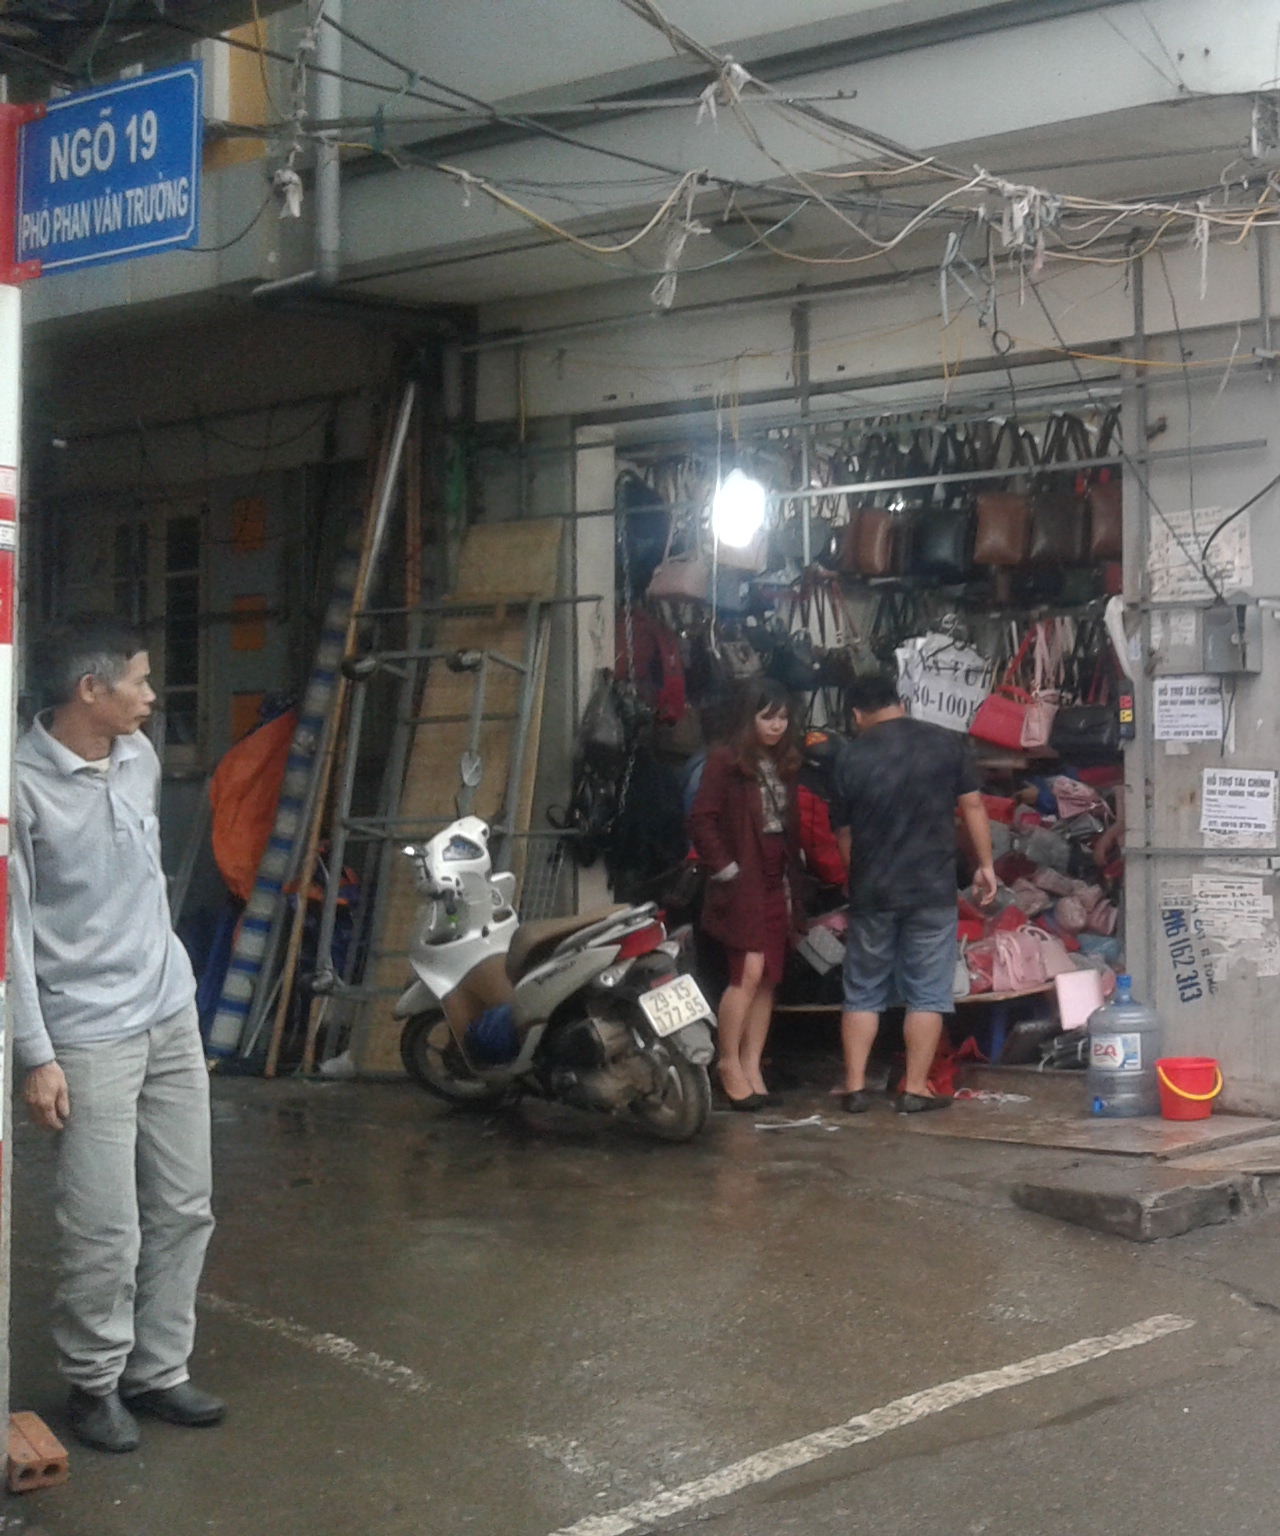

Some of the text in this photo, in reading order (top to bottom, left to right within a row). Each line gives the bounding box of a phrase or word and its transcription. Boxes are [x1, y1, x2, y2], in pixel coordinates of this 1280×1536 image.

[50, 107, 158, 184] NGÕ 19
[52, 199, 91, 244] PHAN
[1168, 938, 1196, 970] 162
